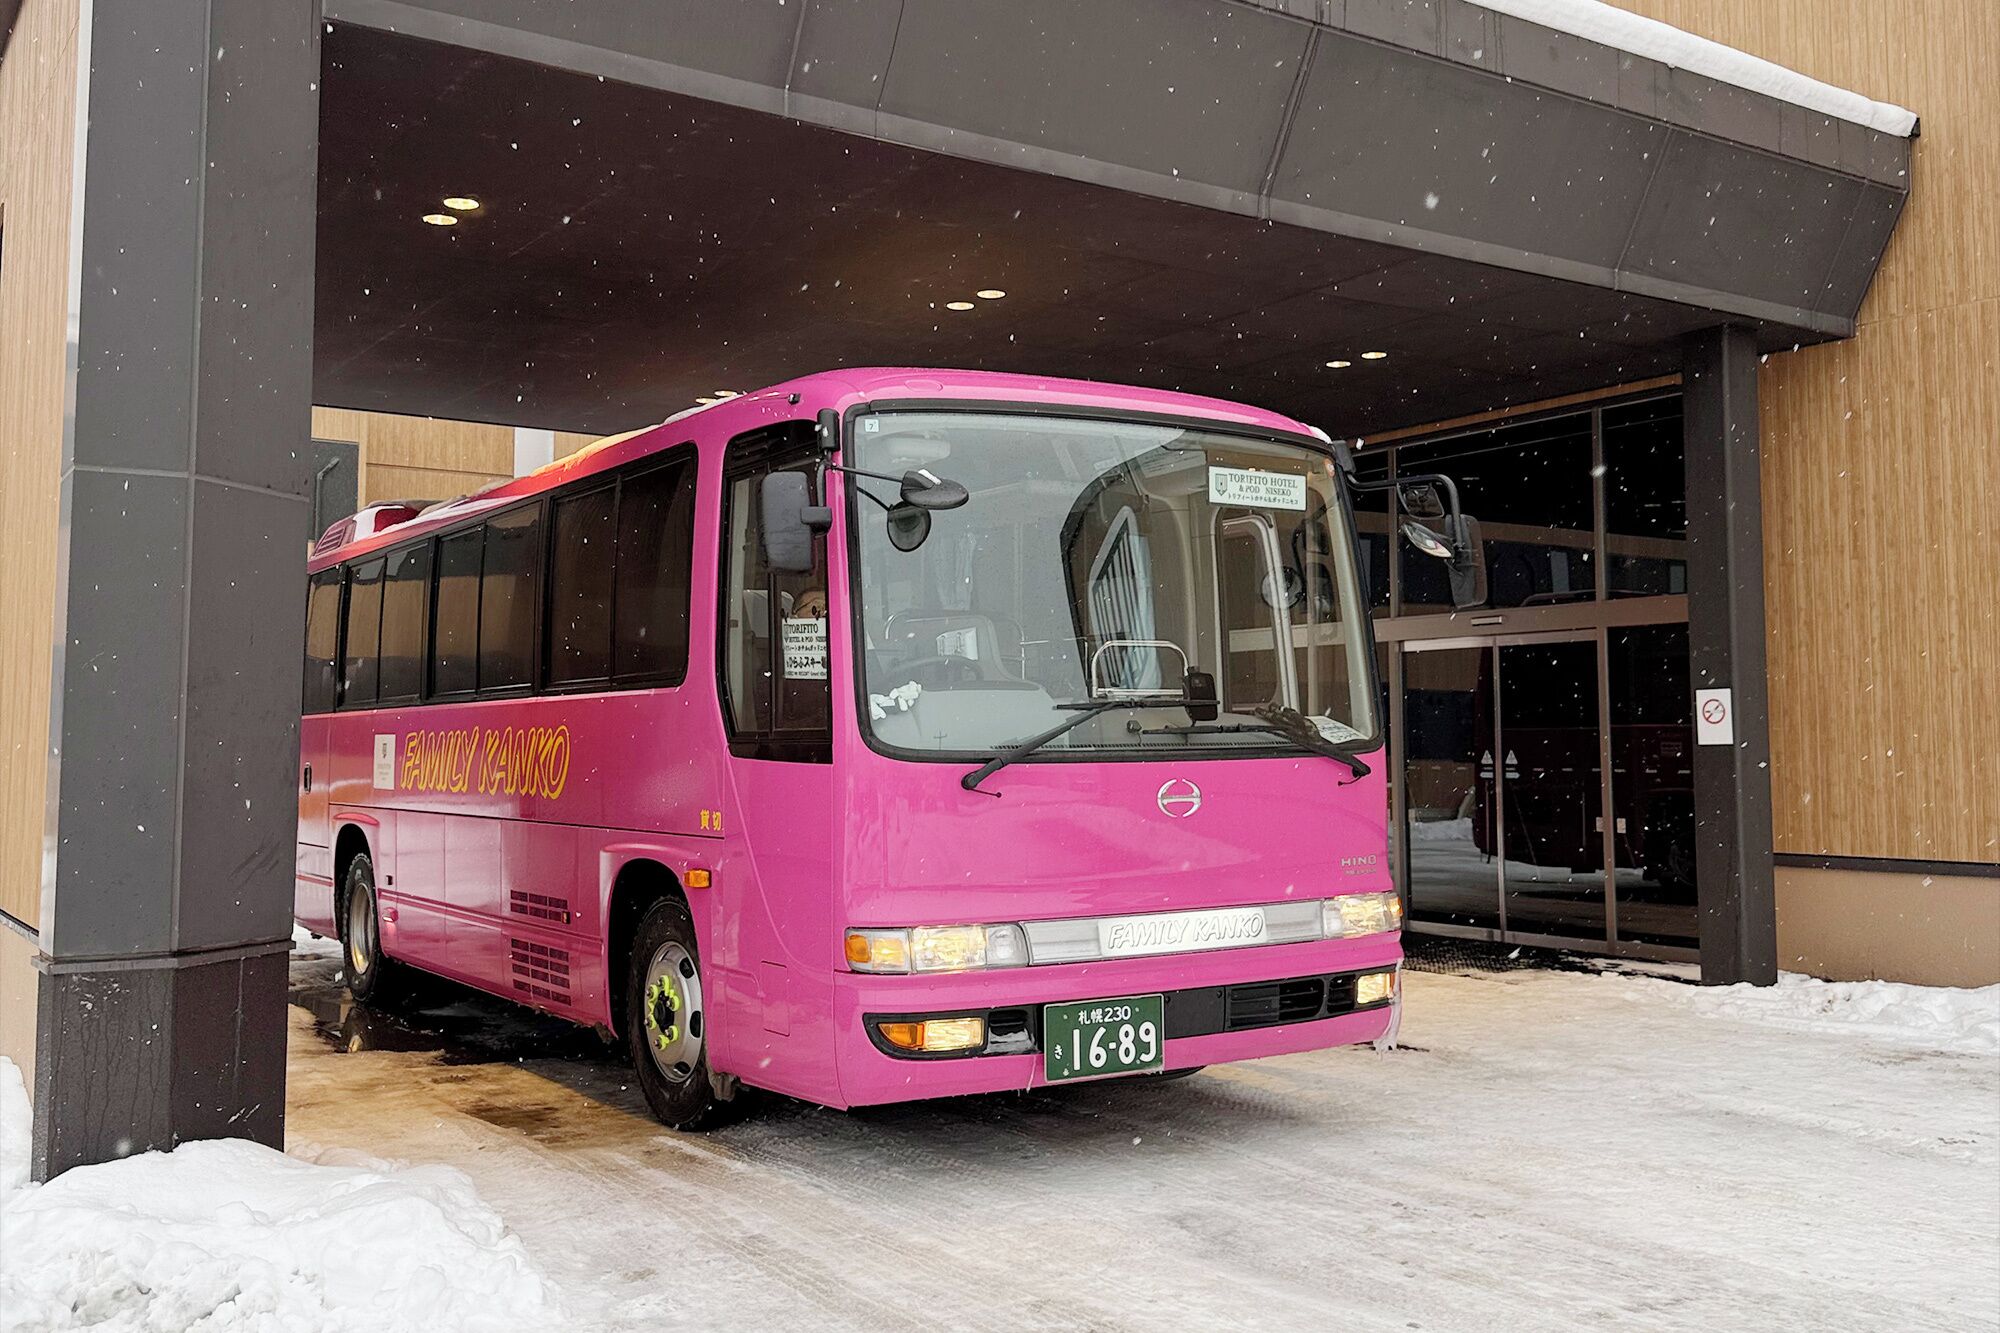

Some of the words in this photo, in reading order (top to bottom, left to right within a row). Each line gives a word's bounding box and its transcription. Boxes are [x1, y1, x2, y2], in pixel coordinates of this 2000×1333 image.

[1228, 473, 1268, 486] TORIFITO
[1270, 477, 1298, 488] HOTEL
[1245, 485, 1260, 494] POD
[1265, 487, 1292, 496] NISEKO
[401, 726, 480, 793] FAMILY
[478, 725, 570, 800] KANKO
[700, 809, 722, 831] 貸切
[1341, 854, 1377, 867] HINO
[1108, 917, 1190, 949] FAMILY
[1193, 912, 1265, 943] KANKO
[1054, 1044, 1063, 1060] き
[1072, 1021, 1157, 1071] 16-89
